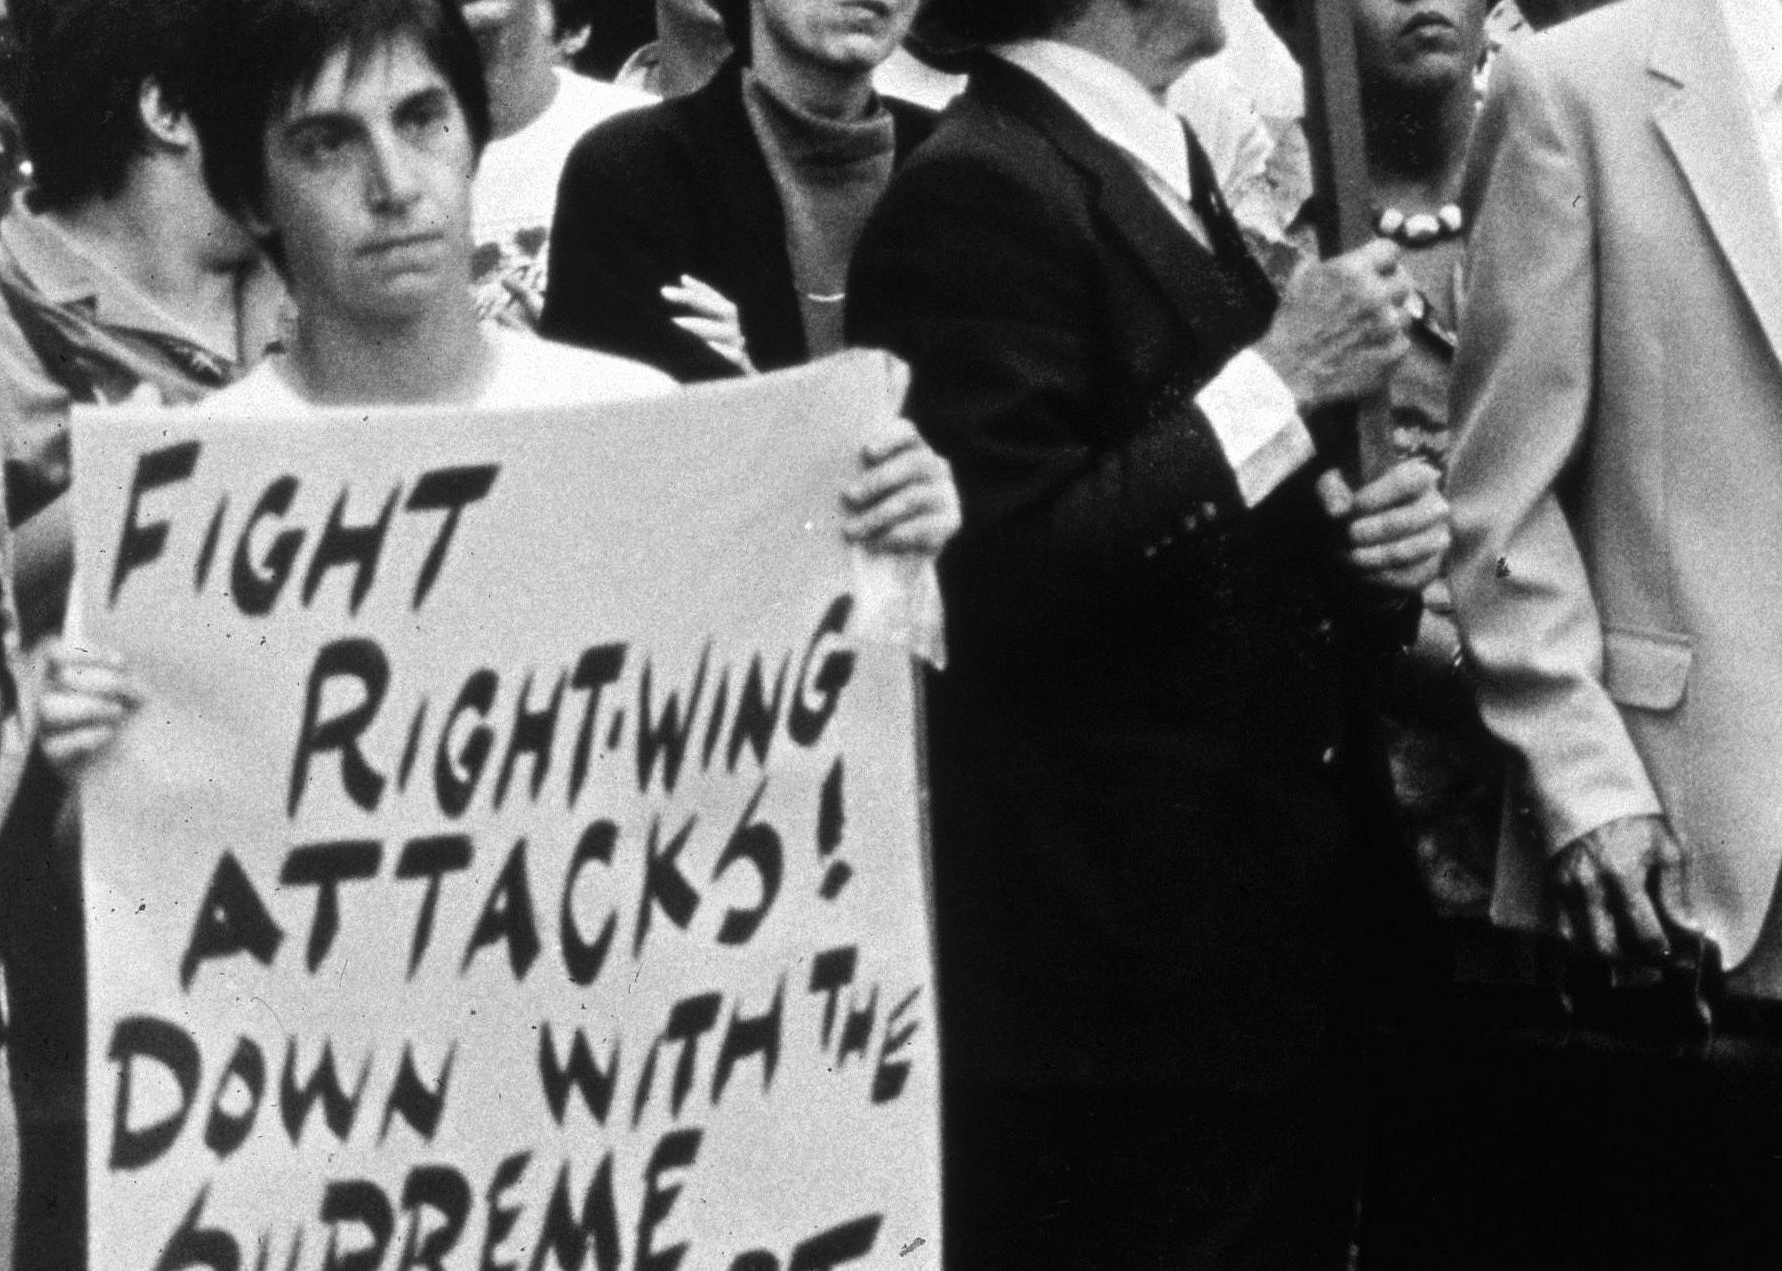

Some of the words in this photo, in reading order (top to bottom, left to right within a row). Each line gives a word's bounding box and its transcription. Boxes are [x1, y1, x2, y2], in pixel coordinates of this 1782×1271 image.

[107, 440, 503, 616] FIGHT
[107, 1014, 457, 1172] DOWN
[538, 970, 788, 1130] WITH
[809, 944, 921, 1106] THE
